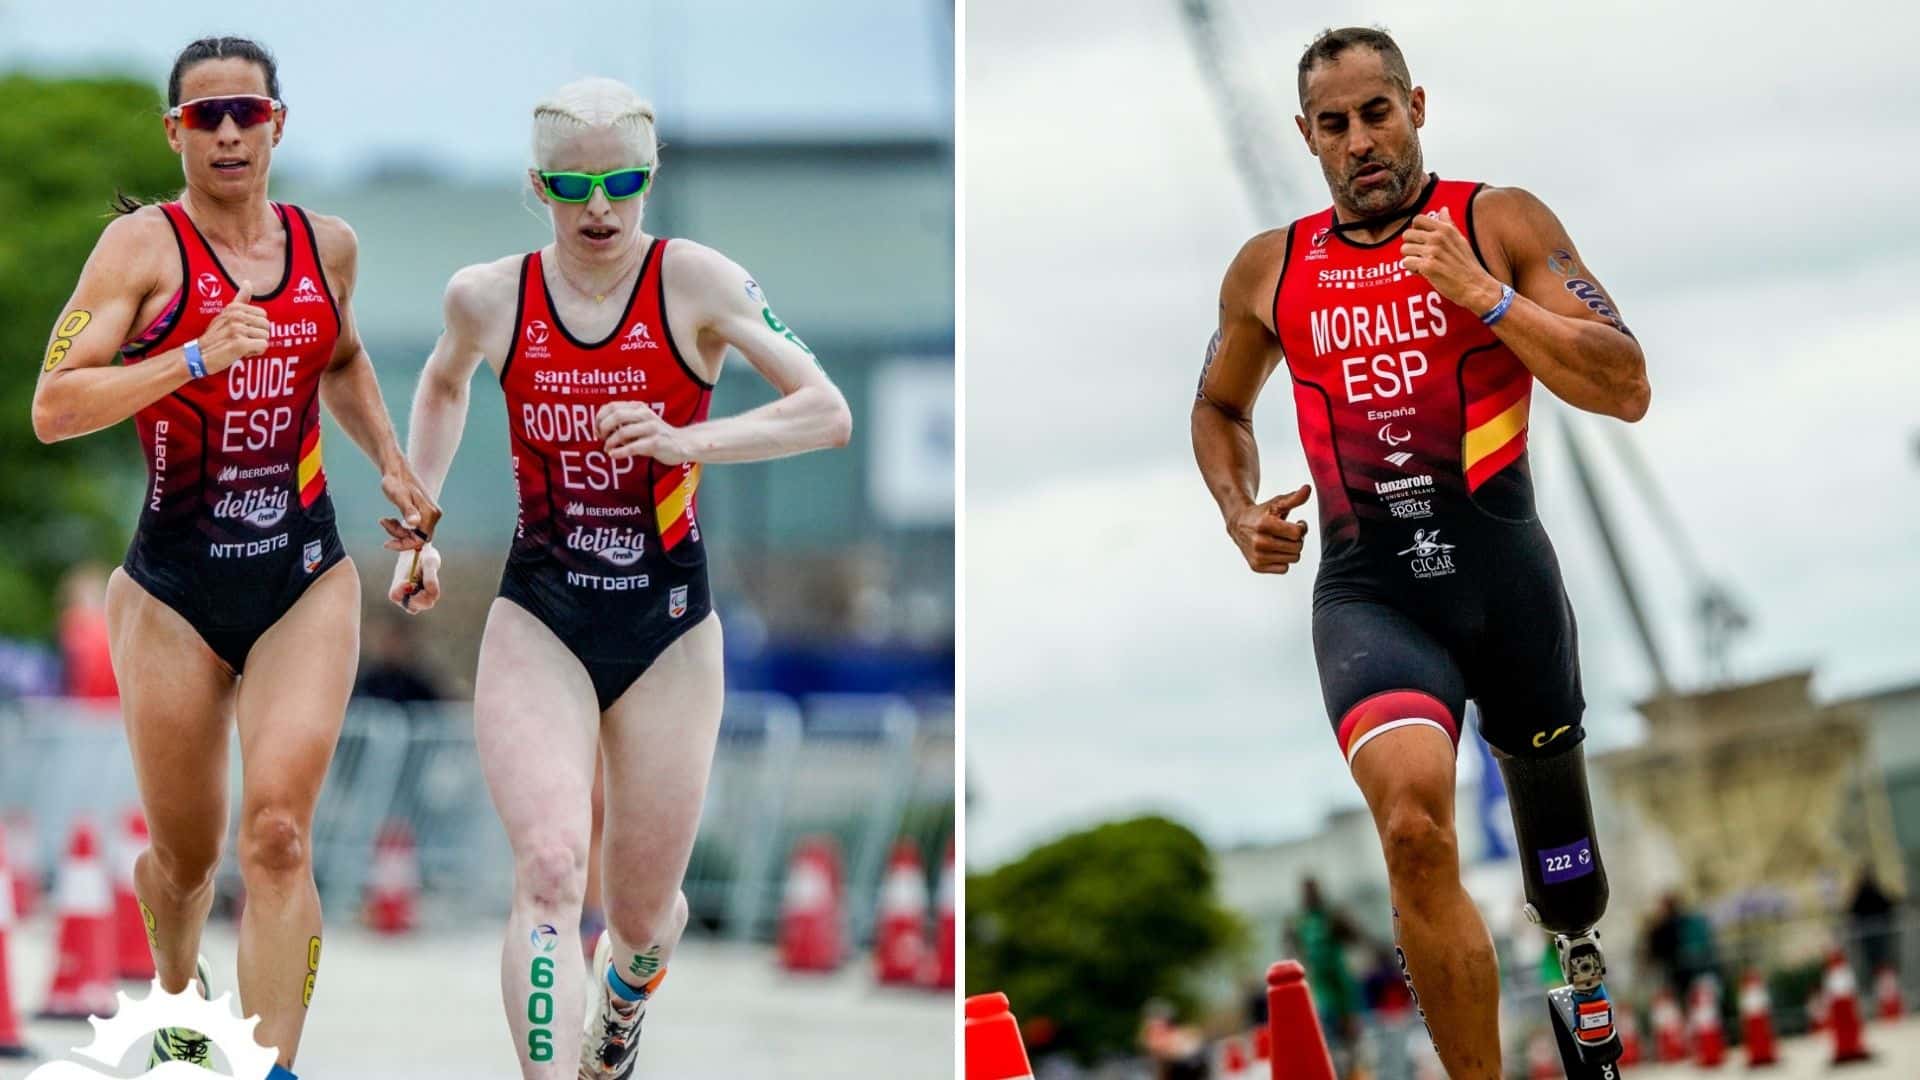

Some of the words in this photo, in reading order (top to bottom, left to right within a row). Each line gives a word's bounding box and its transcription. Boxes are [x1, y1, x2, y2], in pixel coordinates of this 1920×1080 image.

[1318, 260, 1406, 281] santaluc
[1310, 292, 1448, 357] MORALES
[228, 356, 299, 400] GUIDE
[534, 366, 646, 385] santalucía
[1342, 349, 1429, 403] ESP
[1367, 406, 1416, 421] España
[222, 406, 292, 453] ESP
[239, 463, 290, 479] IBERDROLA
[560, 450, 634, 490] ESP
[150, 473, 166, 512] NTT
[1375, 474, 1433, 495] Lanzarote
[257, 510, 278, 522] fresh
[586, 504, 641, 517] IBERDROLA
[1390, 499, 1431, 518] sports
[210, 543, 245, 559] NTT
[612, 549, 634, 560] fresh
[1411, 554, 1455, 573] CICAR
[567, 571, 602, 590] NTT
[1546, 853, 1573, 872] 222
[527, 956, 555, 1062] 606
